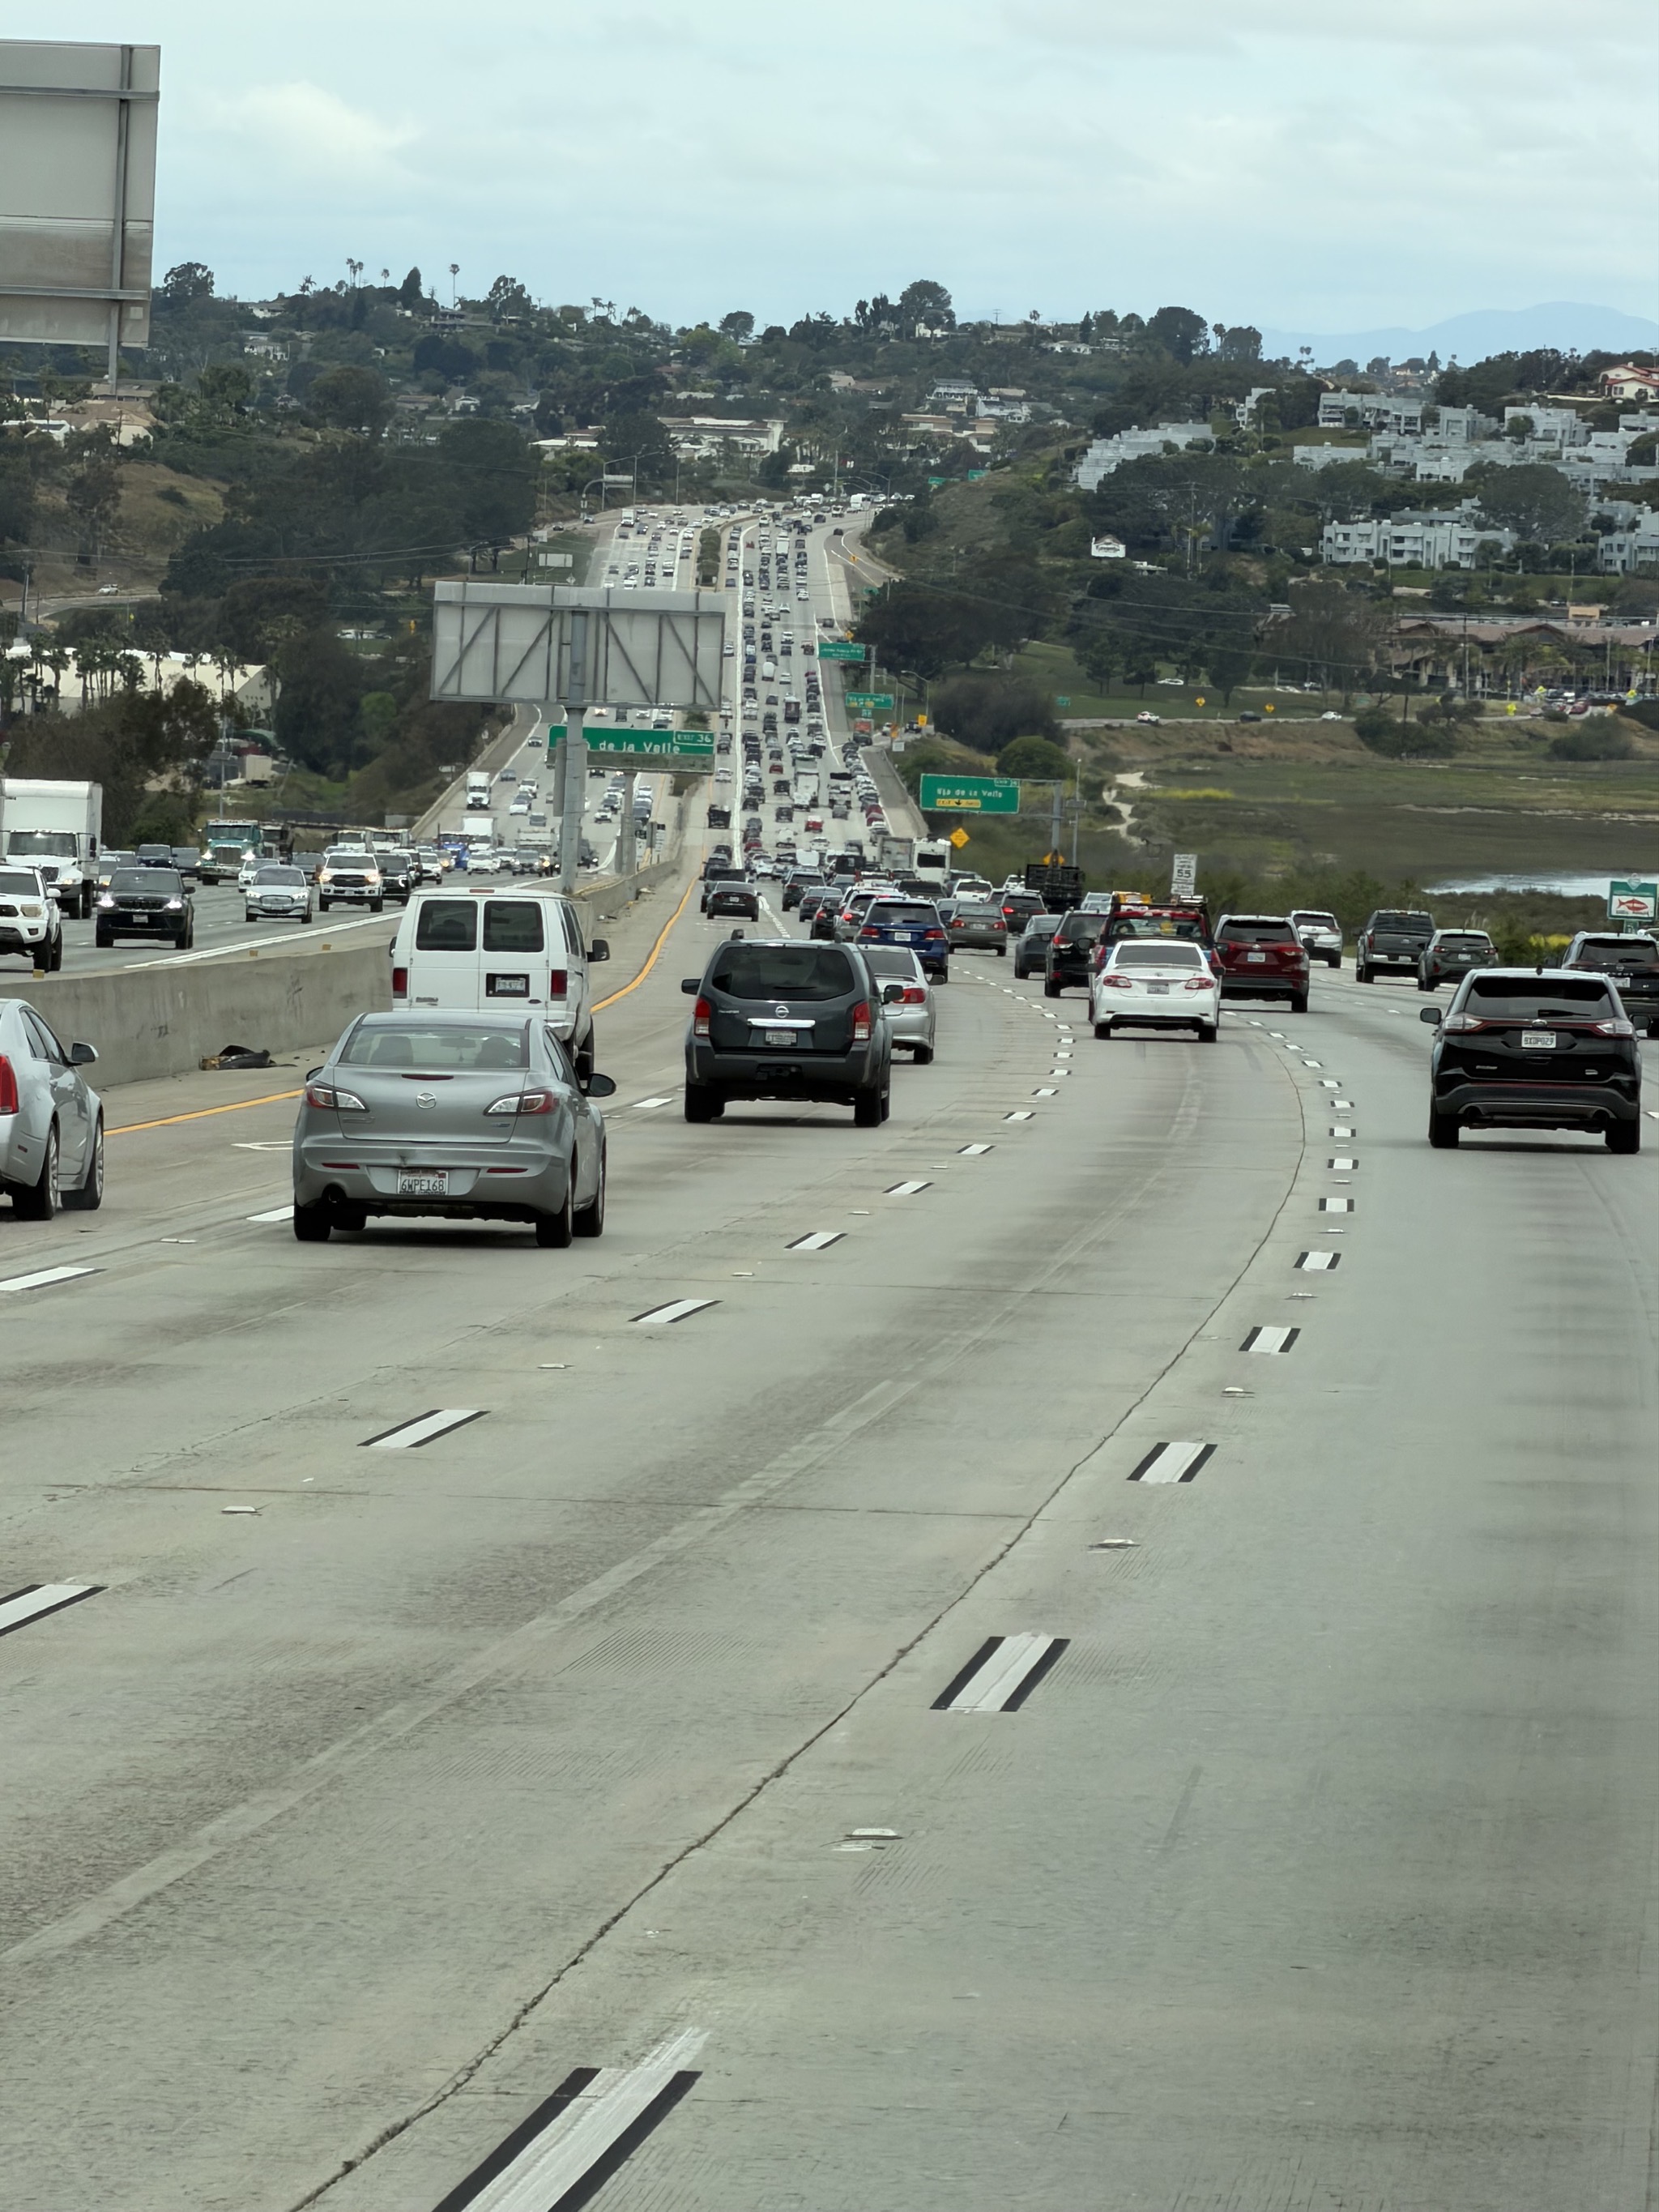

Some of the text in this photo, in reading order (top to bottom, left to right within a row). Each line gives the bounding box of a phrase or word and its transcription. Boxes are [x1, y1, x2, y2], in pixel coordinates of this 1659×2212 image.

[697, 734, 711, 743] 36
[599, 741, 615, 750] de
[622, 741, 635, 752] la
[643, 741, 680, 754] Valle
[1177, 869, 1192, 878] 55
[401, 1178, 444, 1191] 6WPE168
